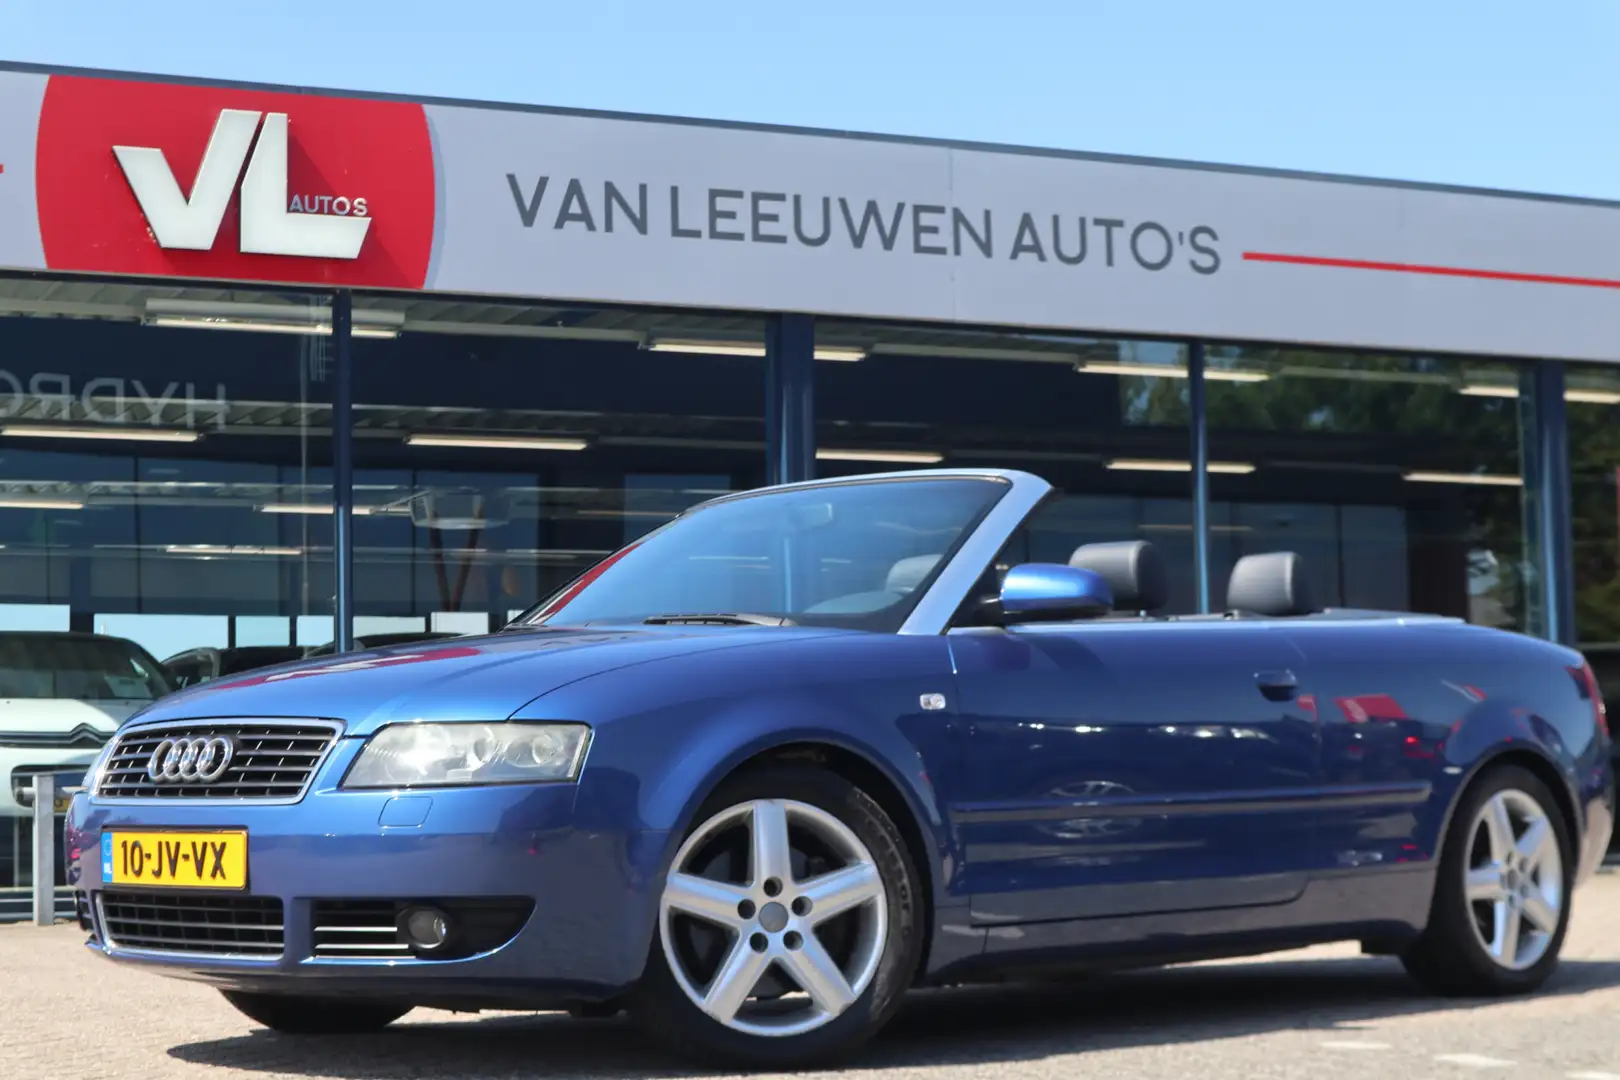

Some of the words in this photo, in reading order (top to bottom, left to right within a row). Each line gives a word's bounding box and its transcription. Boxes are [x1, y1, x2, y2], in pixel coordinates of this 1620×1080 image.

[112, 108, 372, 259] VL
[288, 193, 368, 217] AUTOS
[505, 173, 648, 236] VAN
[670, 185, 993, 259] LEEUWEN
[1009, 212, 1222, 275] AUTO'S
[121, 840, 227, 880] 10-JV-VX
